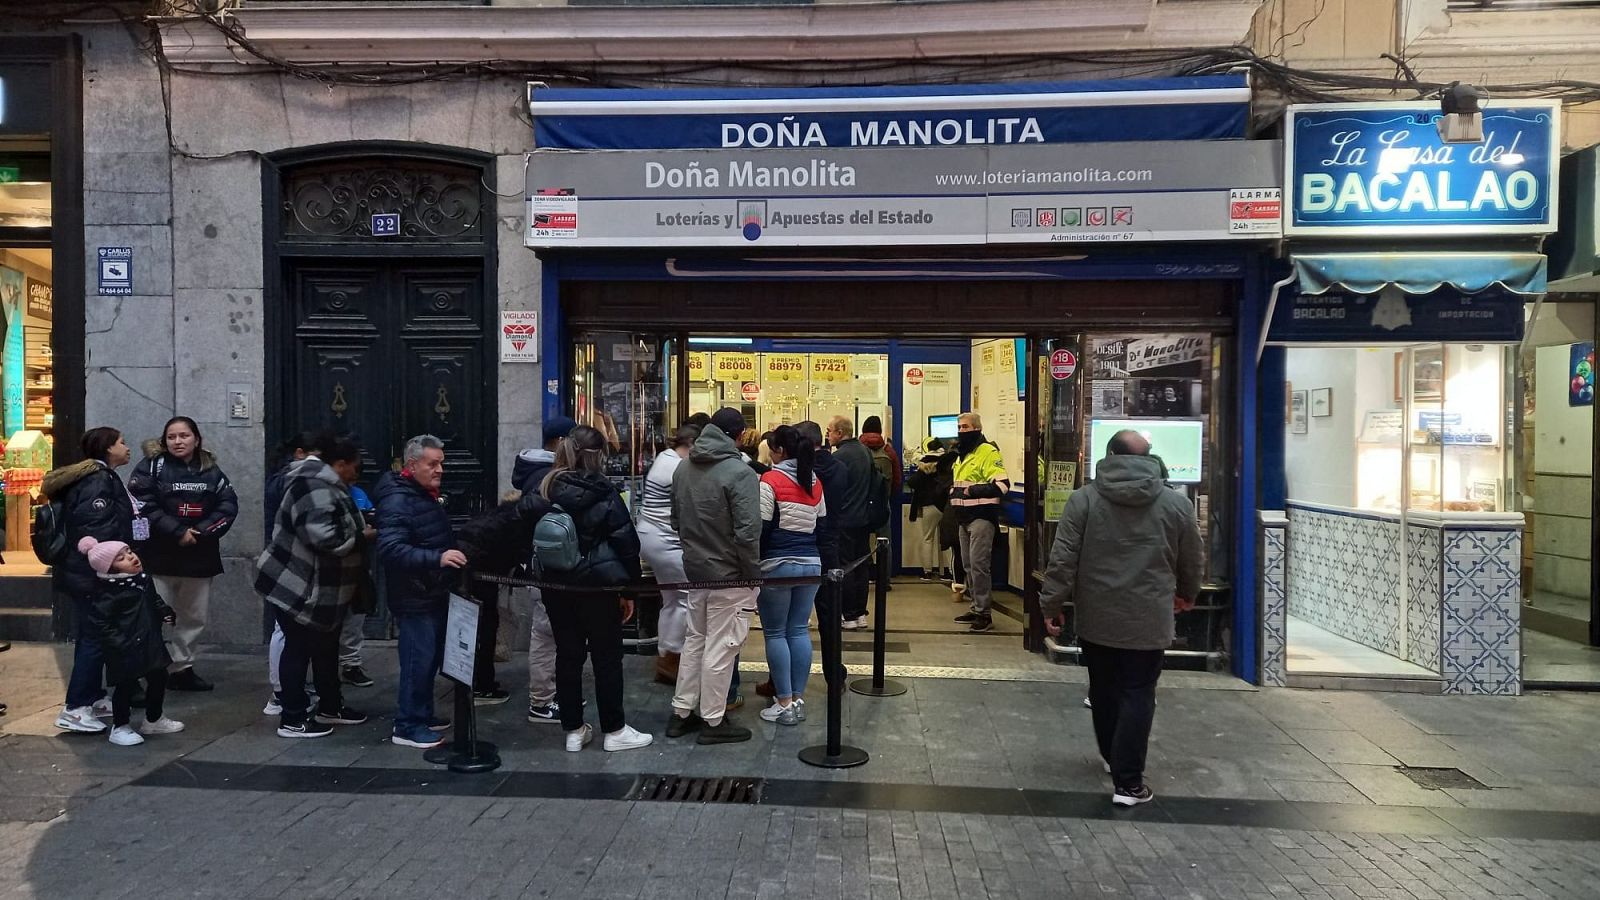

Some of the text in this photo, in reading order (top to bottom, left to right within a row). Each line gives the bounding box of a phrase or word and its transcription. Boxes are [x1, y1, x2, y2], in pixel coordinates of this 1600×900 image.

[1416, 113, 1429, 123] 20
[721, 115, 1045, 148] DOÑA MANOLITA
[1321, 130, 1368, 166] La
[1469, 131, 1524, 165] del
[645, 159, 856, 188] Doña Manolita
[935, 168, 1153, 185] www.loteriamanolita.com
[1231, 191, 1281, 199] ALARMA
[1302, 170, 1539, 213] BACALAO
[376, 217, 394, 231] 22
[656, 209, 934, 229] Loterías y Apuestas del Estado
[1233, 222, 1249, 230] 24h
[1050, 233, 1111, 241] Administración
[1293, 308, 1346, 320] BACALAO
[719, 361, 752, 370] 88008
[769, 362, 802, 371] 88979
[814, 363, 847, 372] 57421
